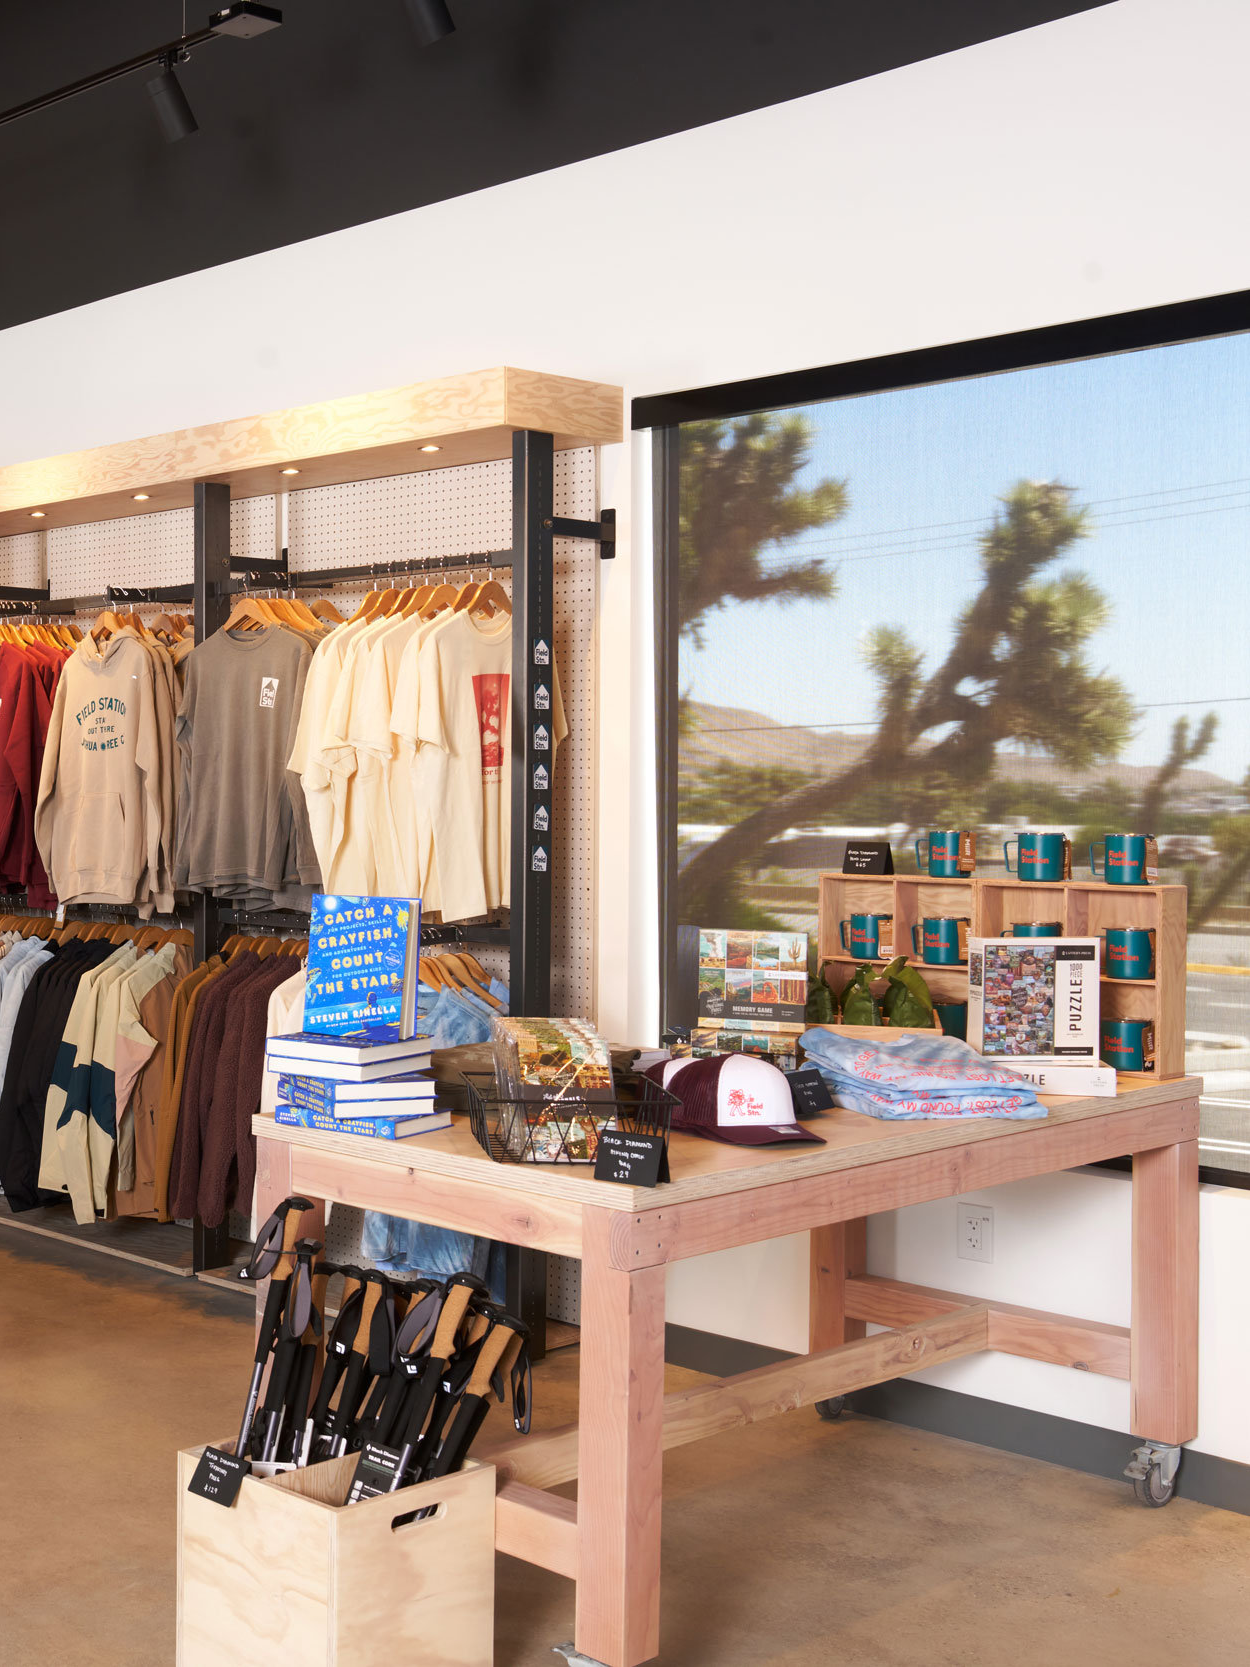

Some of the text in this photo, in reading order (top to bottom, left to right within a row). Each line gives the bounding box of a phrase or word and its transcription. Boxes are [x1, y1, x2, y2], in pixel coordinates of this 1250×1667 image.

[76, 697, 126, 726] FIELD STATIO
[106, 738, 118, 750] REE
[536, 814, 547, 822] Field
[1108, 850, 1126, 858] Field
[534, 855, 546, 864] Field
[1021, 856, 1050, 864] Station
[1108, 858, 1138, 866] Station
[324, 904, 392, 926] CATCH A
[924, 932, 940, 940] Field
[924, 940, 950, 948] Station
[1109, 944, 1128, 952] Field
[332, 952, 383, 970] COUNT
[1109, 952, 1140, 962] Station
[316, 972, 398, 994] THE STARS
[1069, 980, 1083, 1032] PUZZLE
[310, 1004, 396, 1024] STEVEN RINELLA
[1104, 1036, 1122, 1045] Field
[1104, 1044, 1134, 1053] Station
[897, 1100, 917, 1112] MY
[920, 1102, 961, 1112] FOUND
[312, 1114, 334, 1122] CATCH
[315, 1122, 337, 1130] COUNT
[626, 1140, 652, 1148] DIAMOND
[372, 1446, 400, 1460] Black Diamon
[368, 1454, 395, 1468] TRAIL CORK
